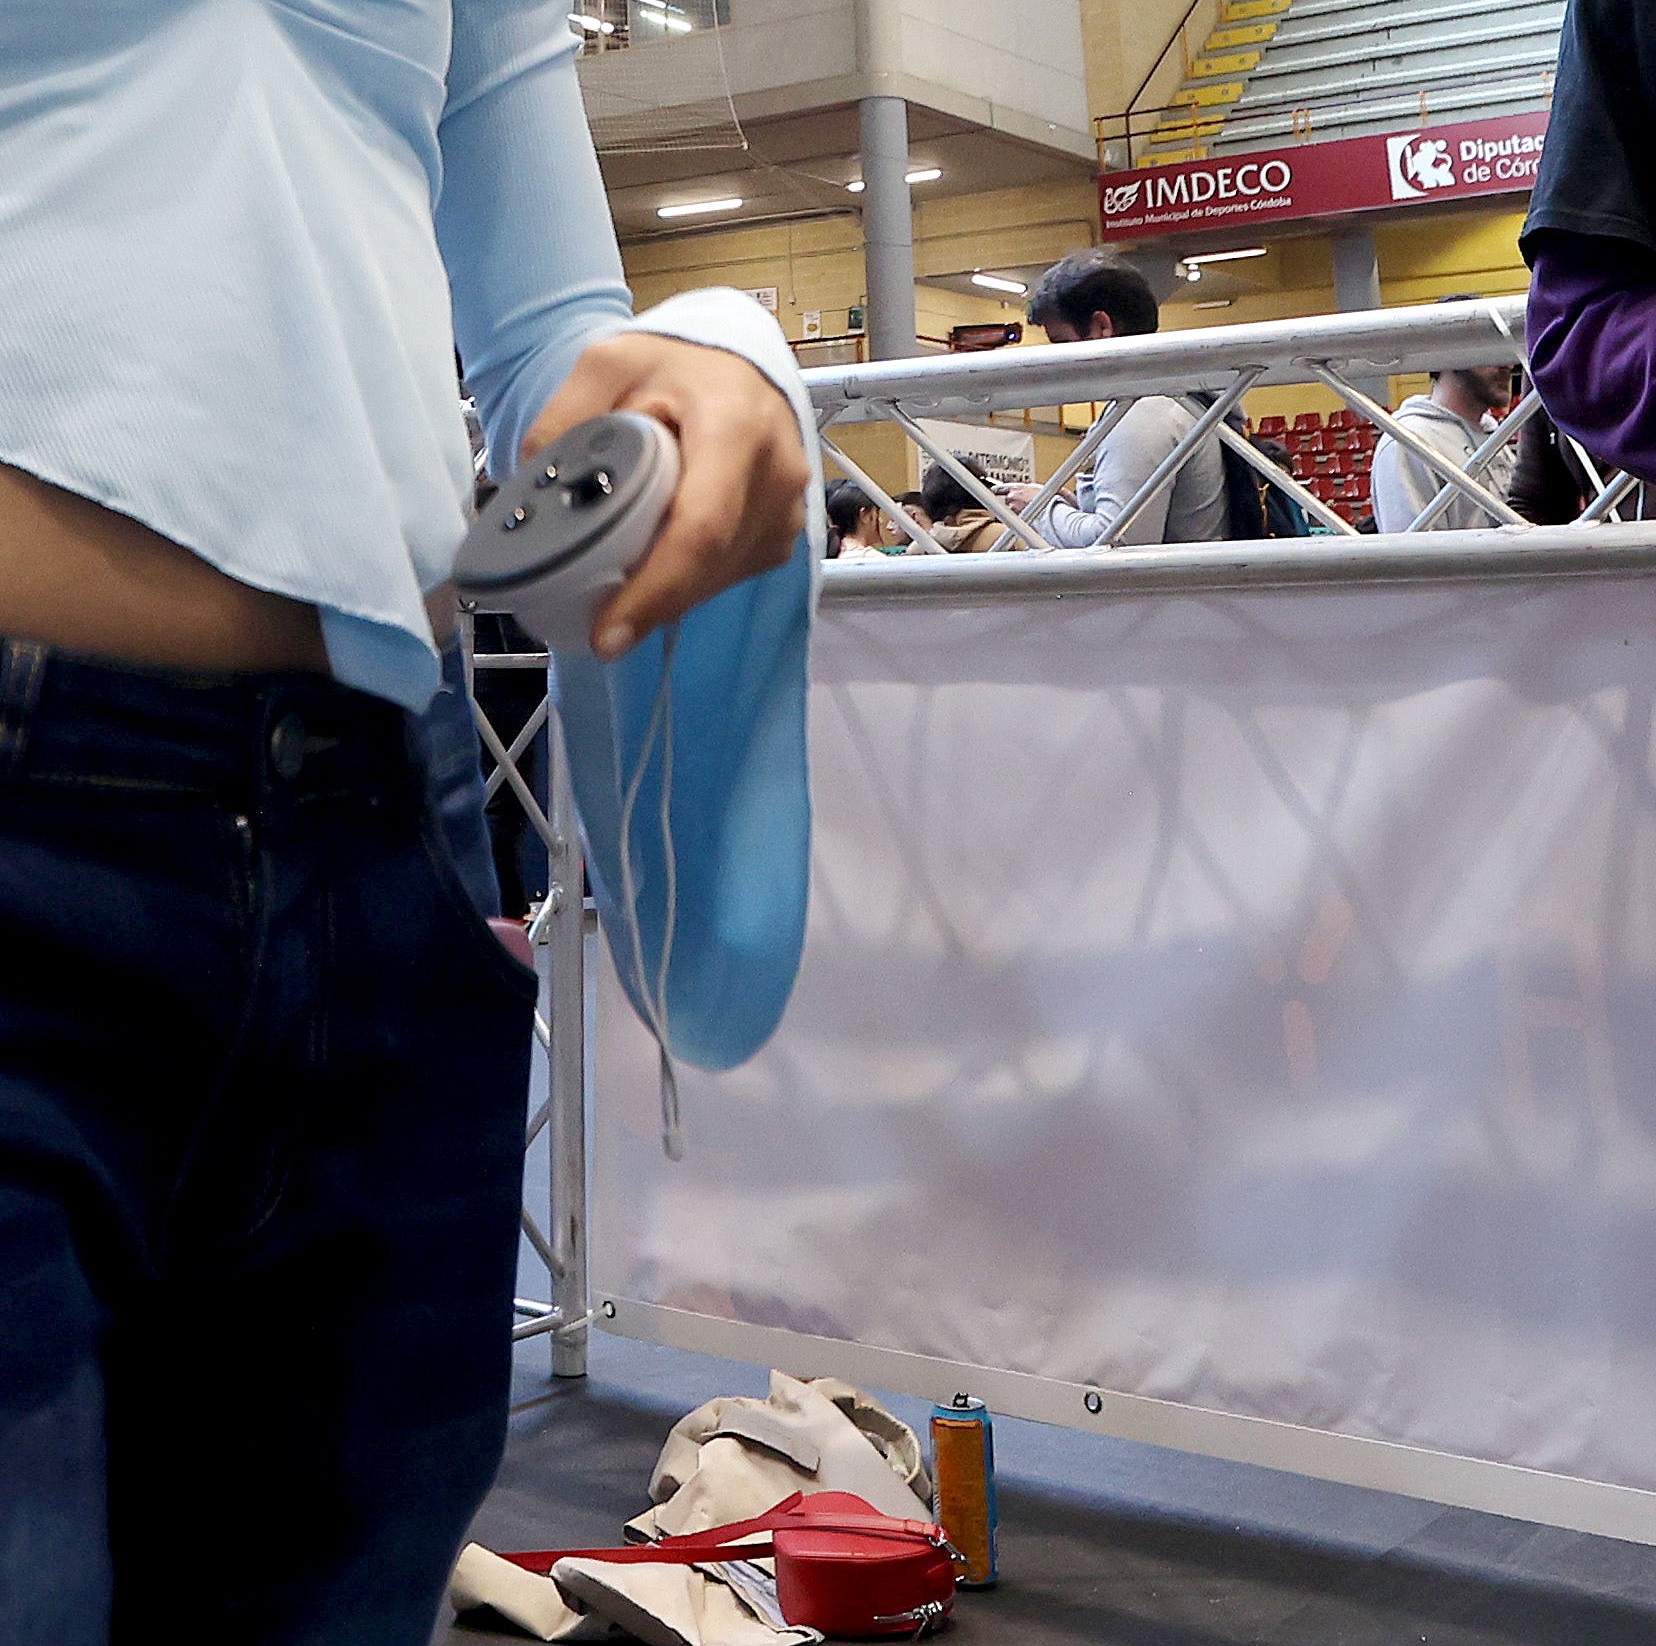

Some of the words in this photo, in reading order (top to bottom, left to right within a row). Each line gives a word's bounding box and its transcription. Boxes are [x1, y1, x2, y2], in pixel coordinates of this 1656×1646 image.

[1144, 160, 1293, 209] IMDECO
[1461, 163, 1492, 184] de
[1145, 209, 1190, 225] Municipal
[1190, 208, 1204, 219] de
[1205, 202, 1249, 218] Deportes
